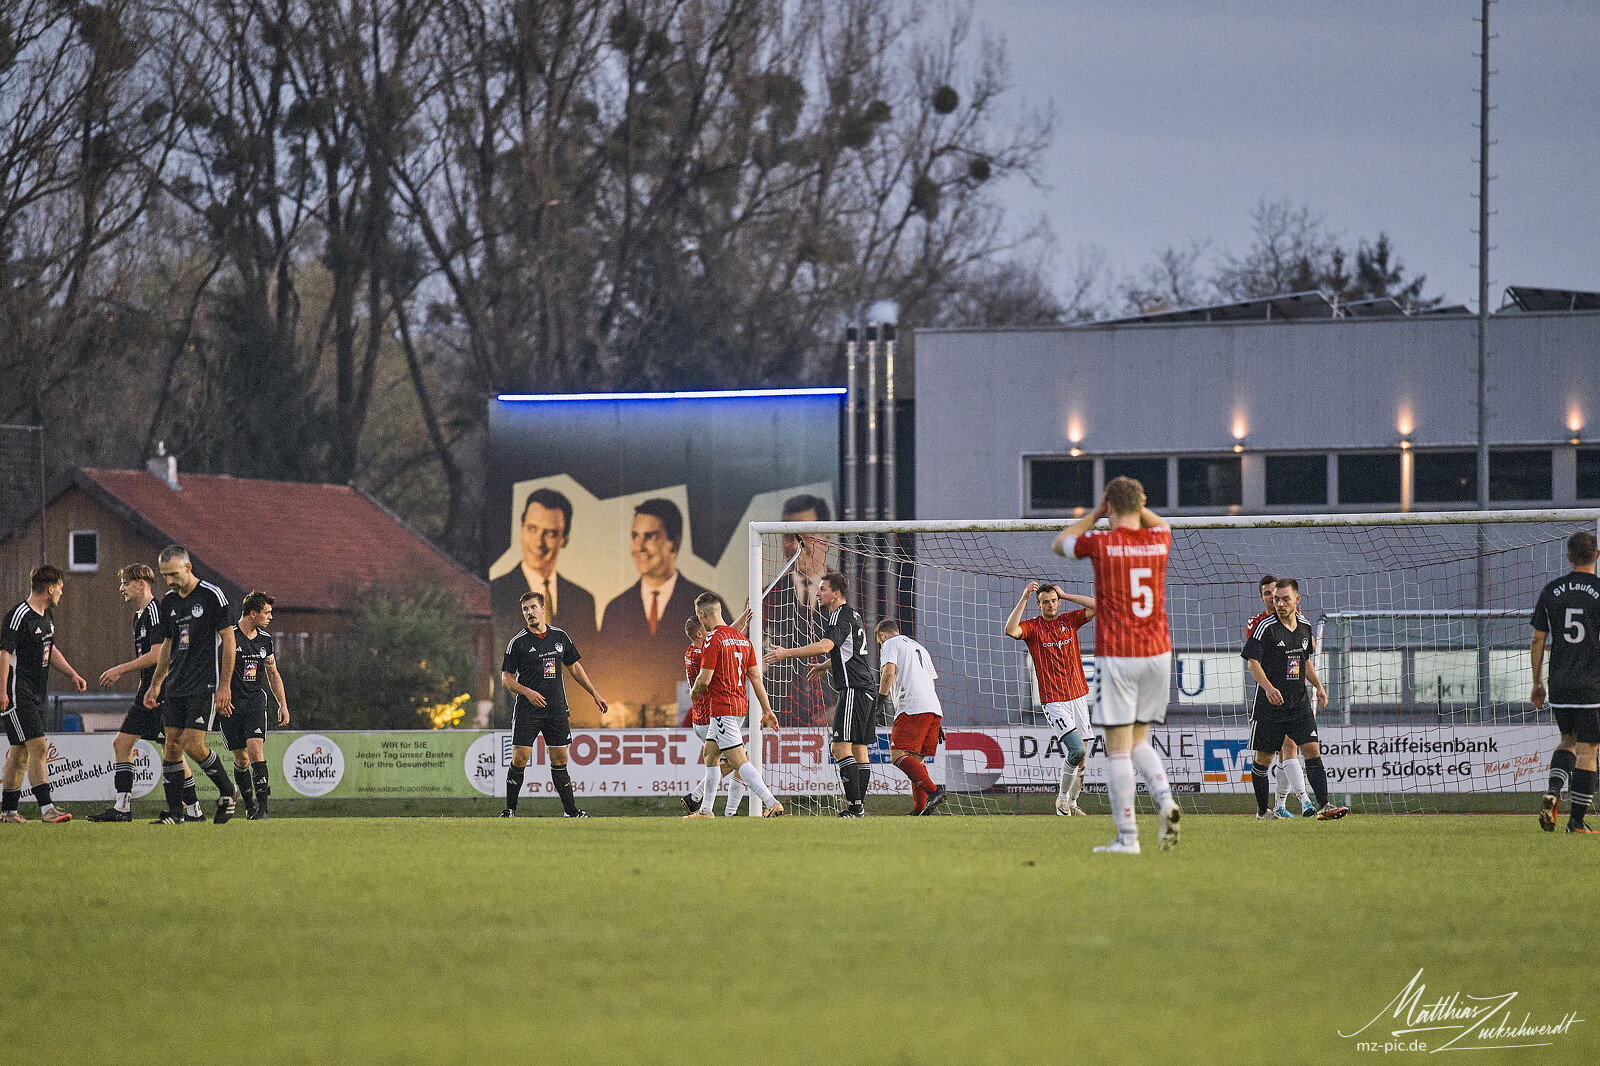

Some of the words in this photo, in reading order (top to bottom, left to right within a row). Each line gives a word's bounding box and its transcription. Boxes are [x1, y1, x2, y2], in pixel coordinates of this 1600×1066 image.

[1130, 568, 1154, 618] 5
[1553, 583, 1566, 597] SV
[1569, 582, 1600, 600] Laufen
[1563, 608, 1586, 643] 5
[857, 628, 868, 656] 2
[1055, 717, 1067, 731] 11
[381, 741, 398, 749] WIR
[400, 741, 411, 749] für
[414, 741, 428, 749] SIE
[537, 734, 687, 766] OBERT
[1368, 737, 1498, 755] Raiffeisenbank
[355, 751, 381, 759] Jeden
[383, 751, 398, 760] Tag
[426, 751, 454, 759] Bestes
[48, 758, 84, 777] Laufen
[1381, 761, 1442, 777] Südost
[1447, 761, 1472, 777] eG
[652, 781, 690, 792] 83411
